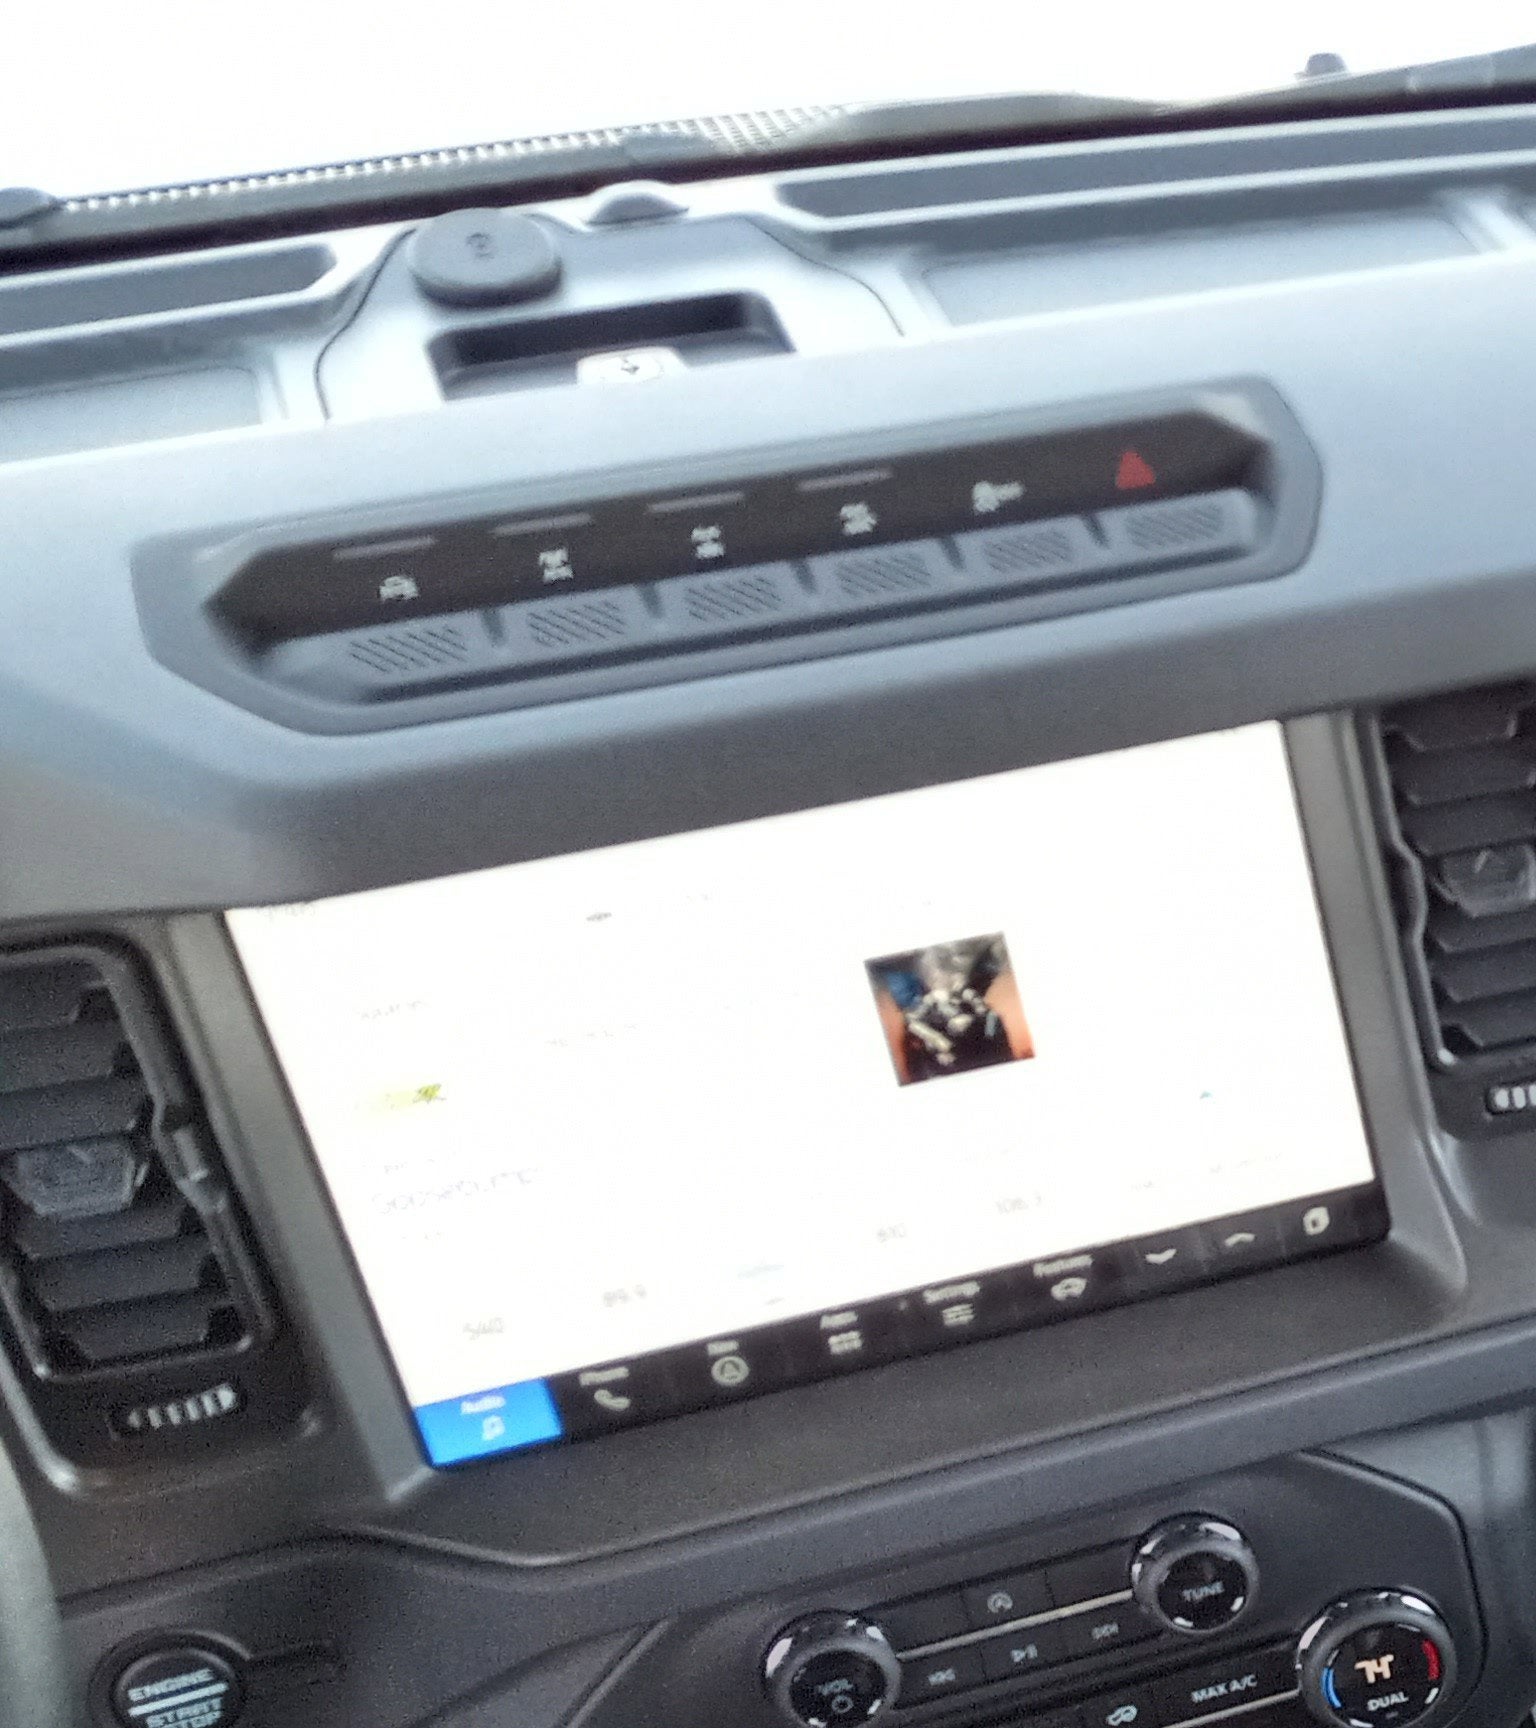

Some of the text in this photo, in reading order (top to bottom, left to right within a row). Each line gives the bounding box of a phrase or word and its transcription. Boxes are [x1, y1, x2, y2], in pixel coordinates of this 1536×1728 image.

[1191, 1674, 1258, 1703] MAX A/C
[1367, 1691, 1409, 1711] DUAL
